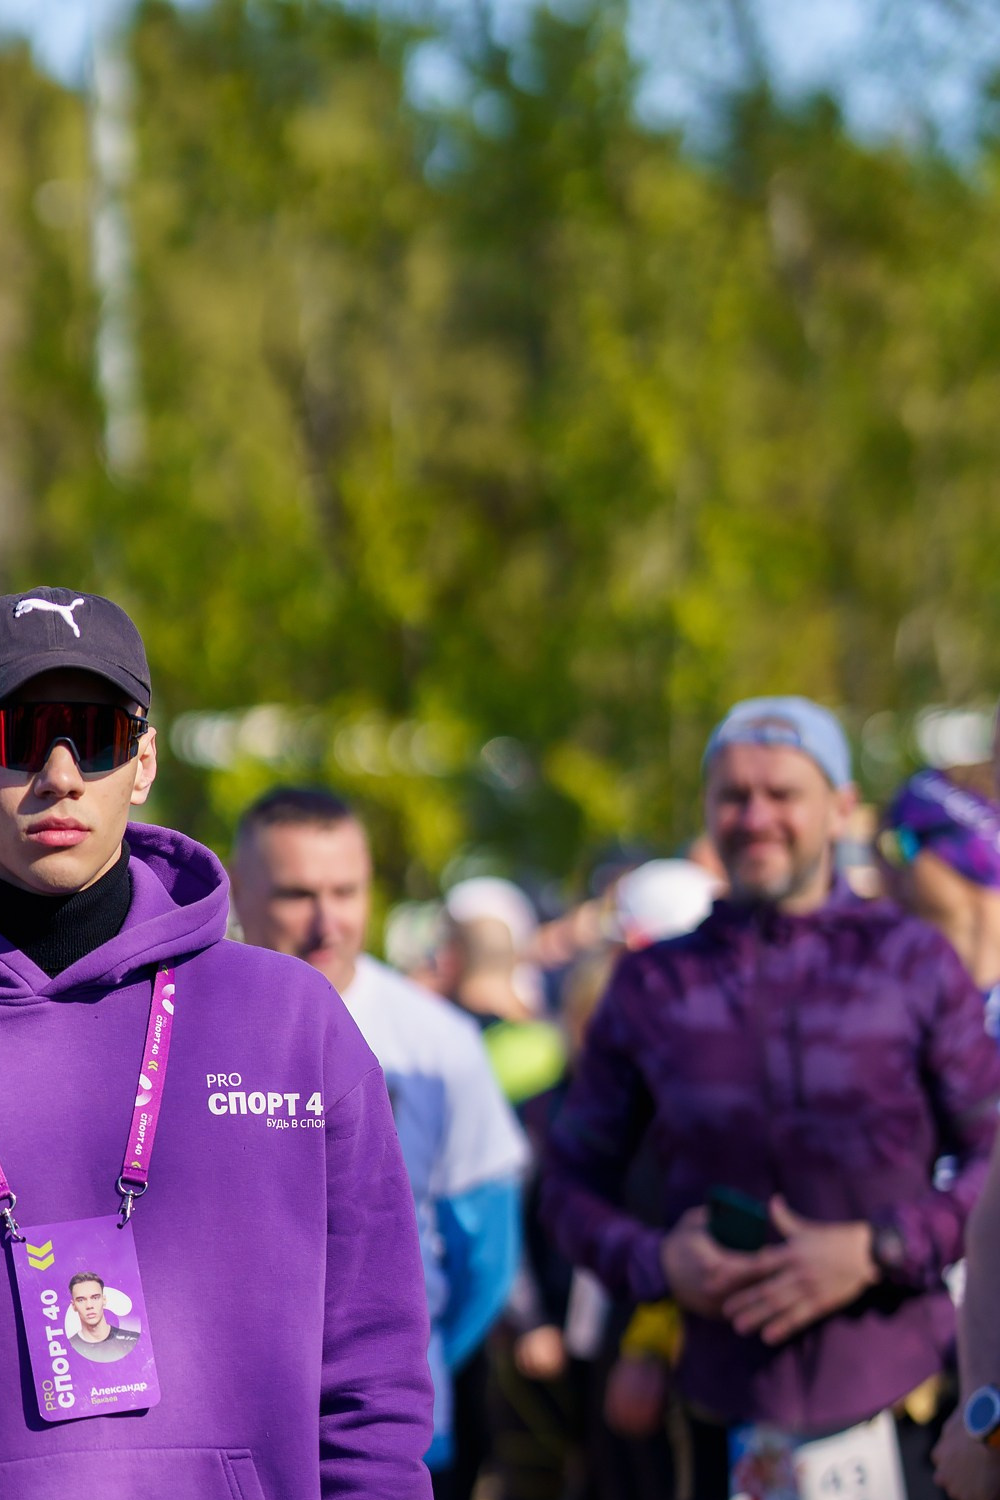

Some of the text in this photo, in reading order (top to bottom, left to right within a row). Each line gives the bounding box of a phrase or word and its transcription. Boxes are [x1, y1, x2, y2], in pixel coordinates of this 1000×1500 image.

[151, 1014, 163, 1055] СПОРТ 40
[206, 1072, 242, 1088] PRO
[208, 1091, 324, 1116] СПОРТ 4
[134, 1112, 148, 1156] СПОРТ 40
[266, 1118, 325, 1130] БУДЬ В СПОР
[40, 1289, 76, 1409] СПОРТ 40
[41, 1379, 57, 1411] PRO
[90, 1382, 148, 1397] Александр
